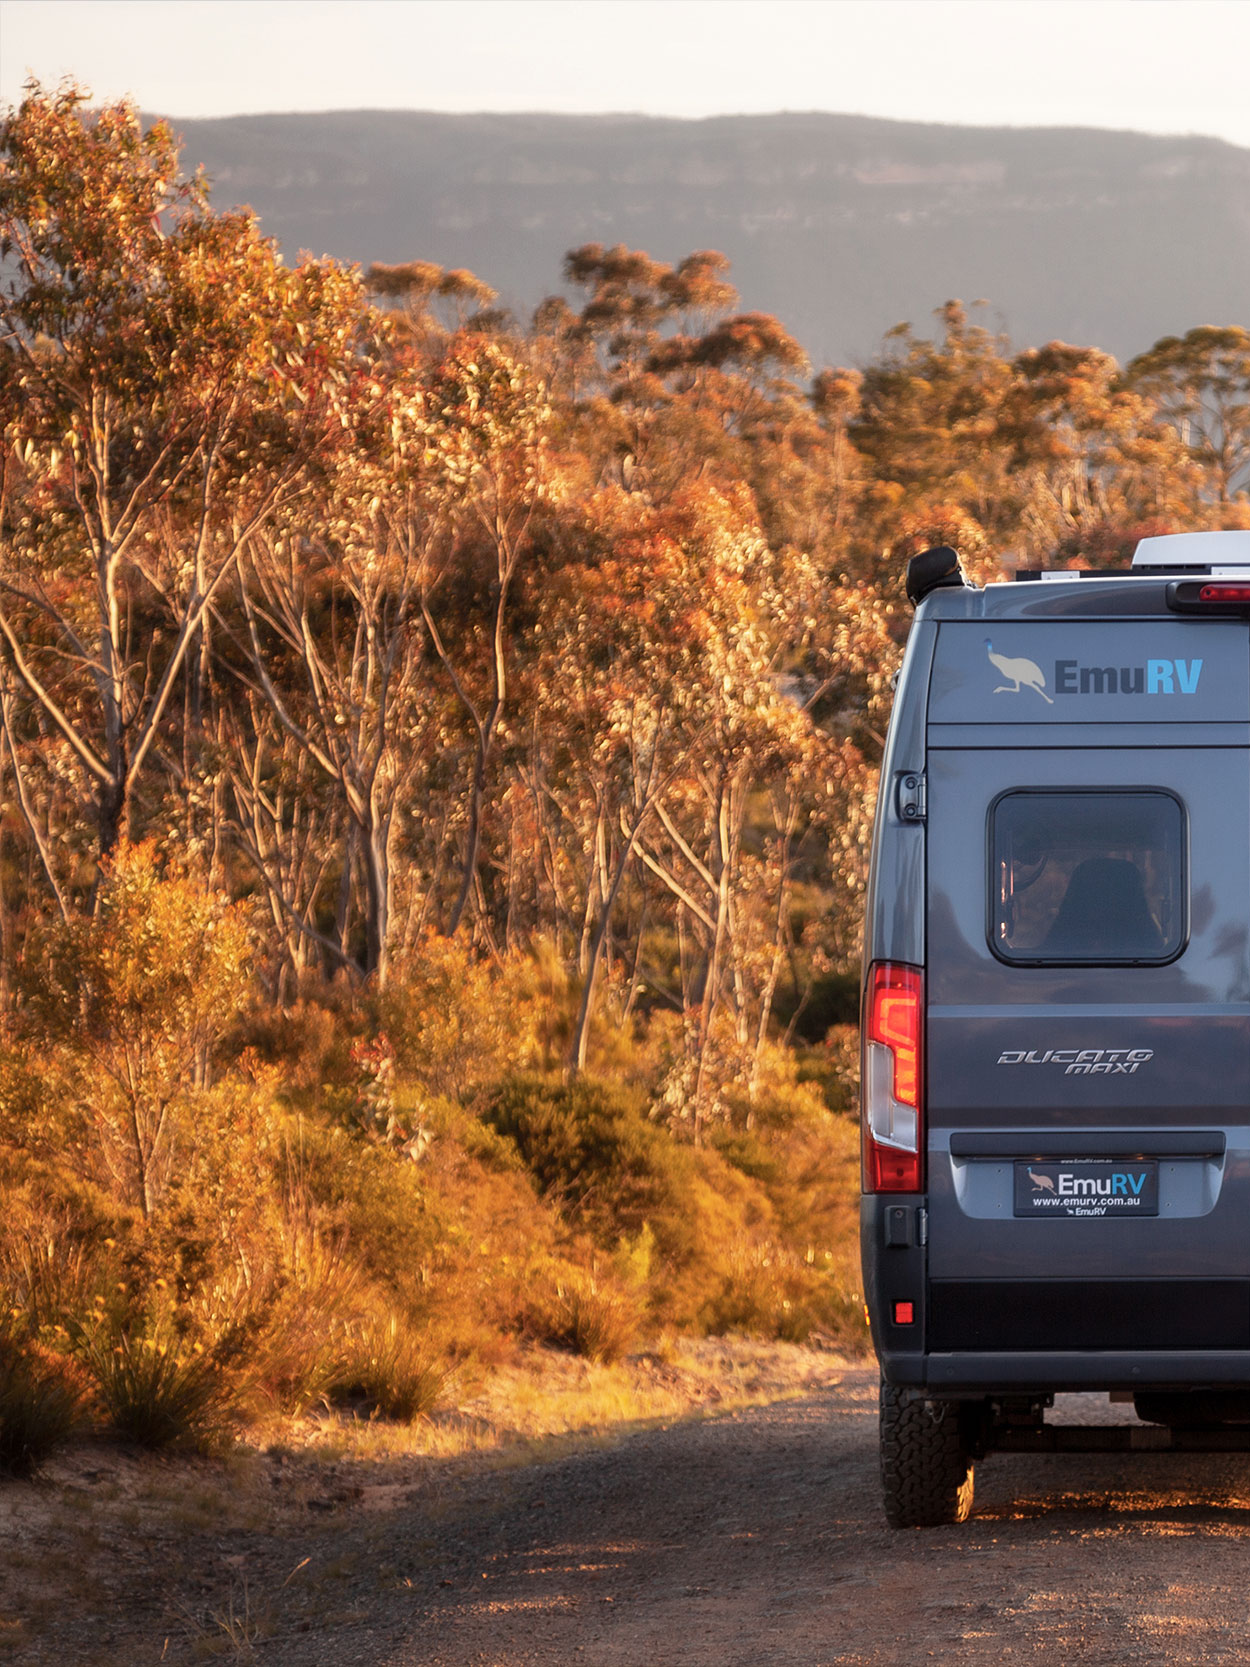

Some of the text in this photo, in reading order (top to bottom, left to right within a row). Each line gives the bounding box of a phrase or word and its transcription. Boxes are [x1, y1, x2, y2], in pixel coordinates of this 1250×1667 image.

[1055, 659, 1203, 694] EmuRV
[997, 1049, 1154, 1064] DUCATO
[1064, 1062, 1140, 1075] MAXI
[1058, 1173, 1146, 1195] EmuRV
[1033, 1197, 1140, 1206] www.emurv.com.au
[1075, 1207, 1107, 1216] EmuRV
